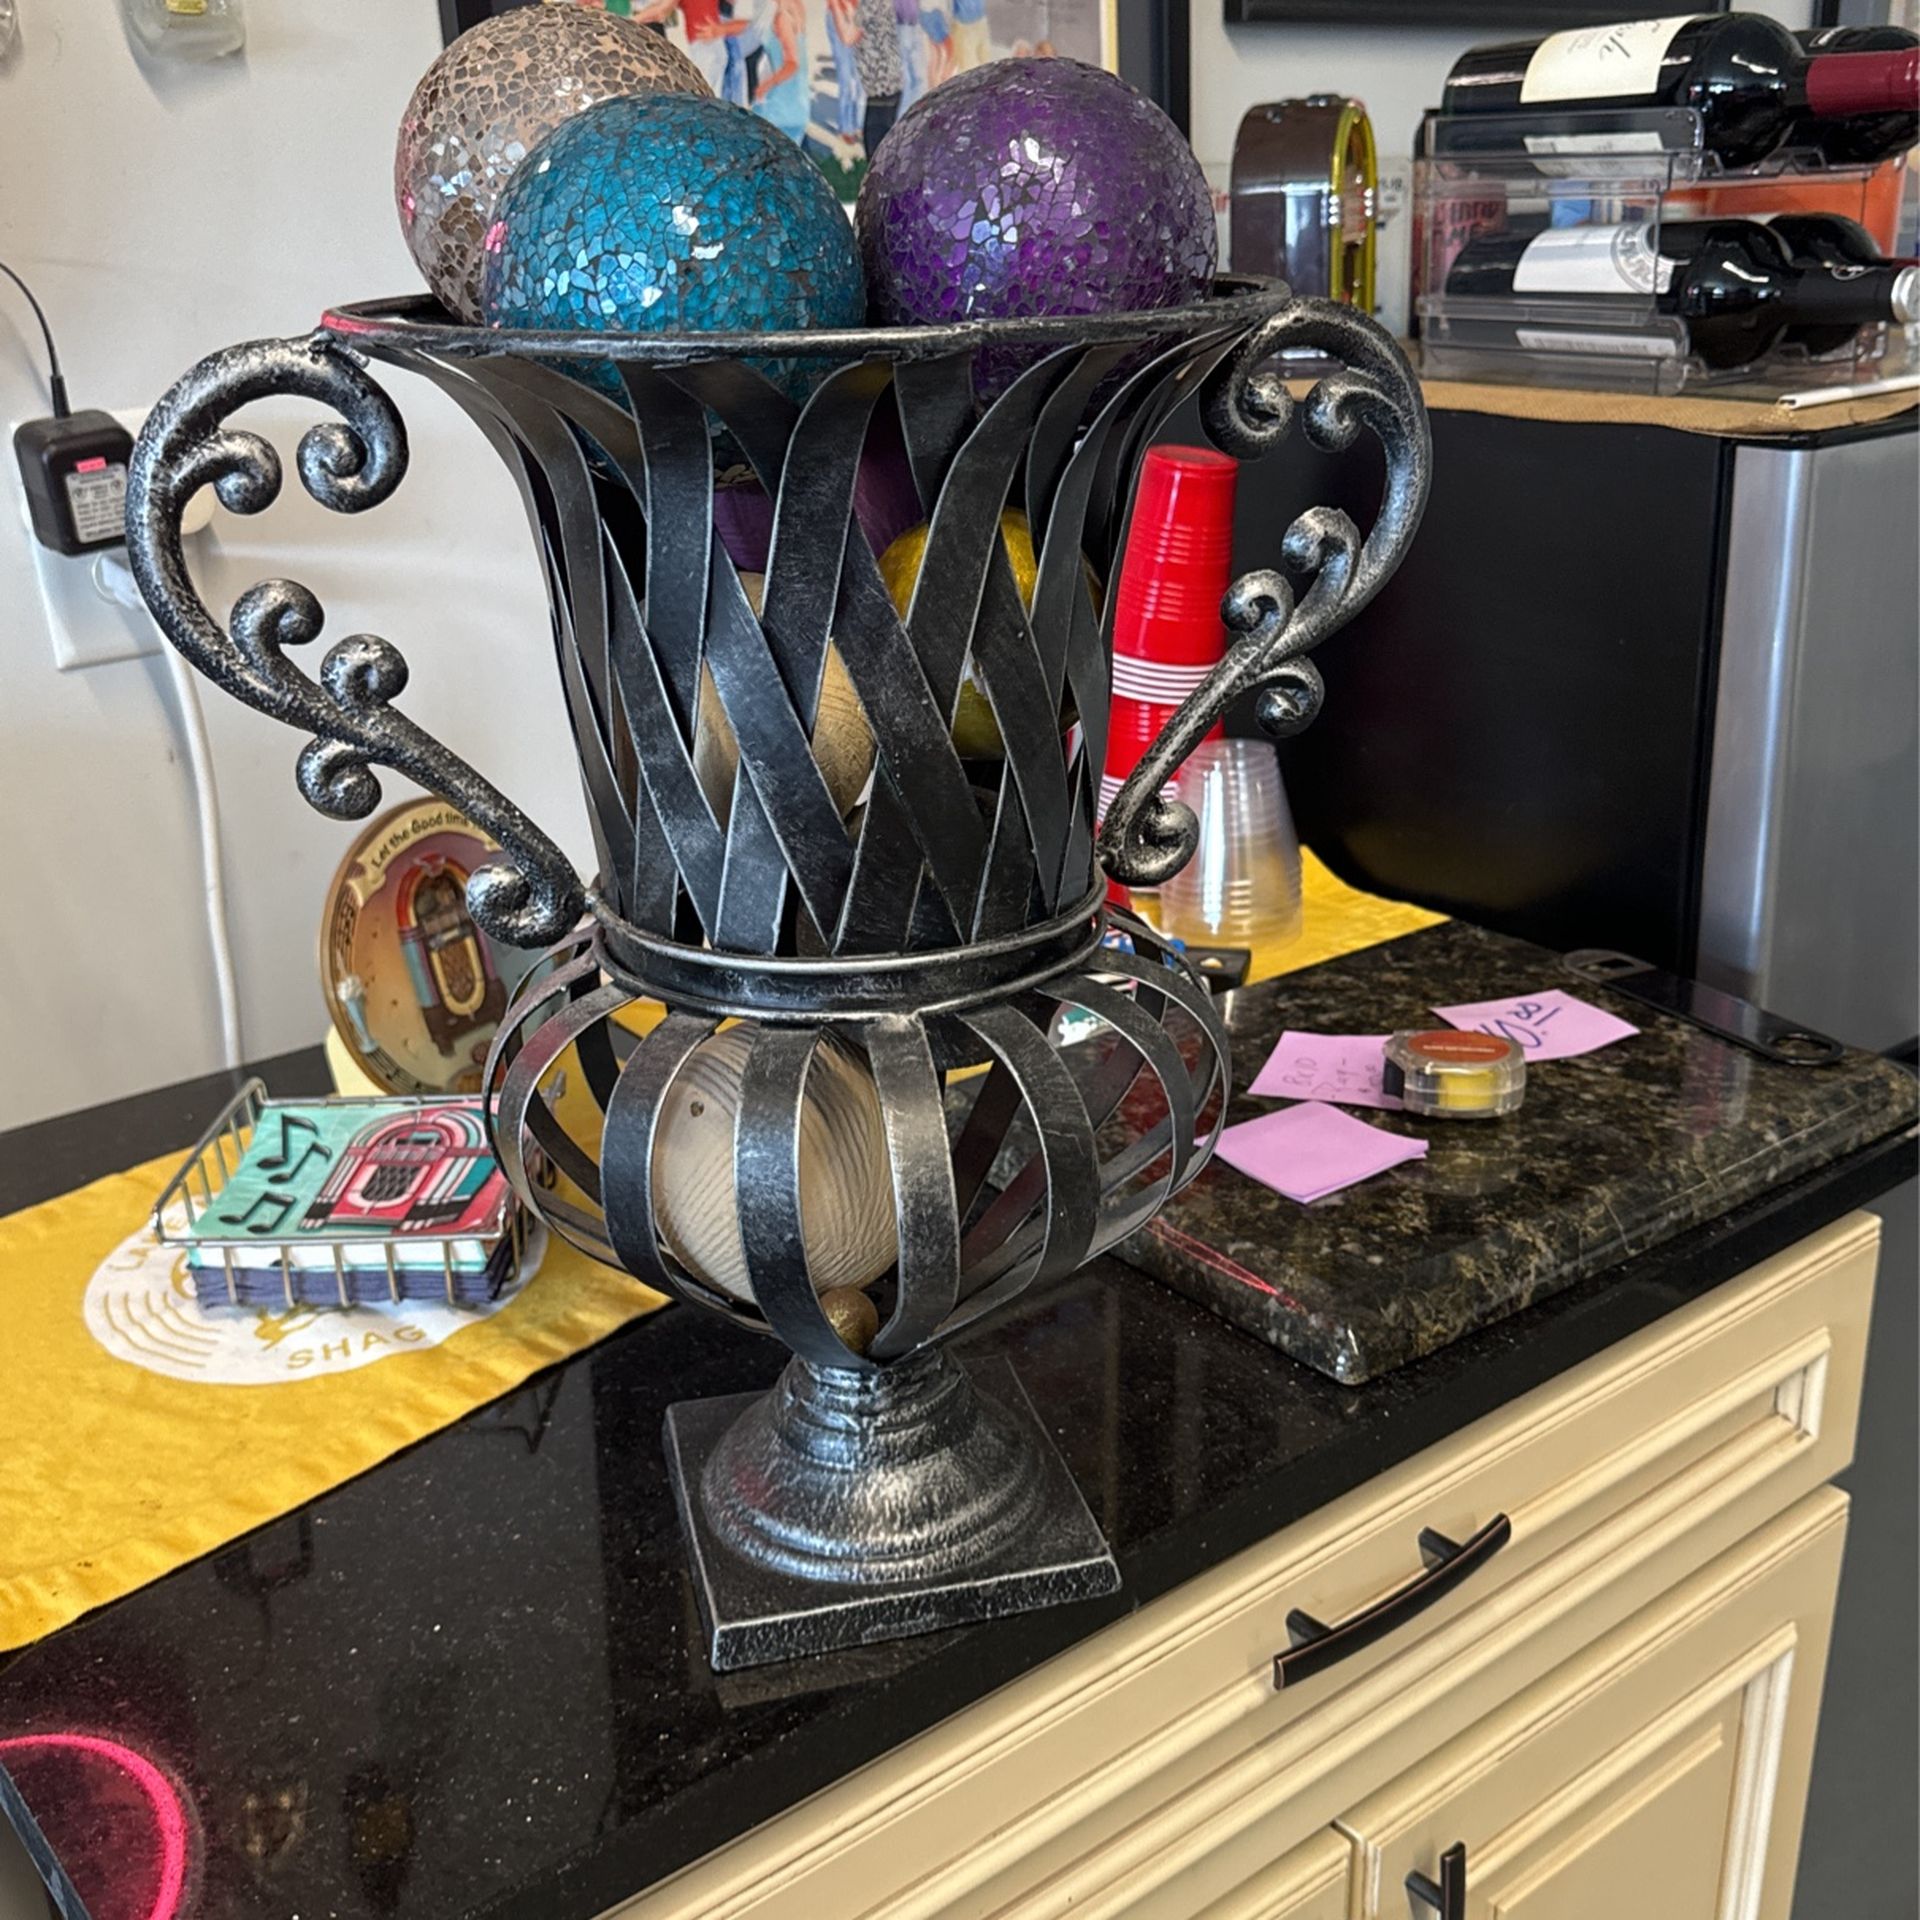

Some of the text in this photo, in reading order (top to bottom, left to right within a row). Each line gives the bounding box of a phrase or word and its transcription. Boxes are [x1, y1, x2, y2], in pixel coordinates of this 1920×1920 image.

[371, 843, 391, 868] Let
[389, 829, 410, 848] the
[411, 812, 443, 833] Good
[287, 1324, 427, 1369] SHAG
